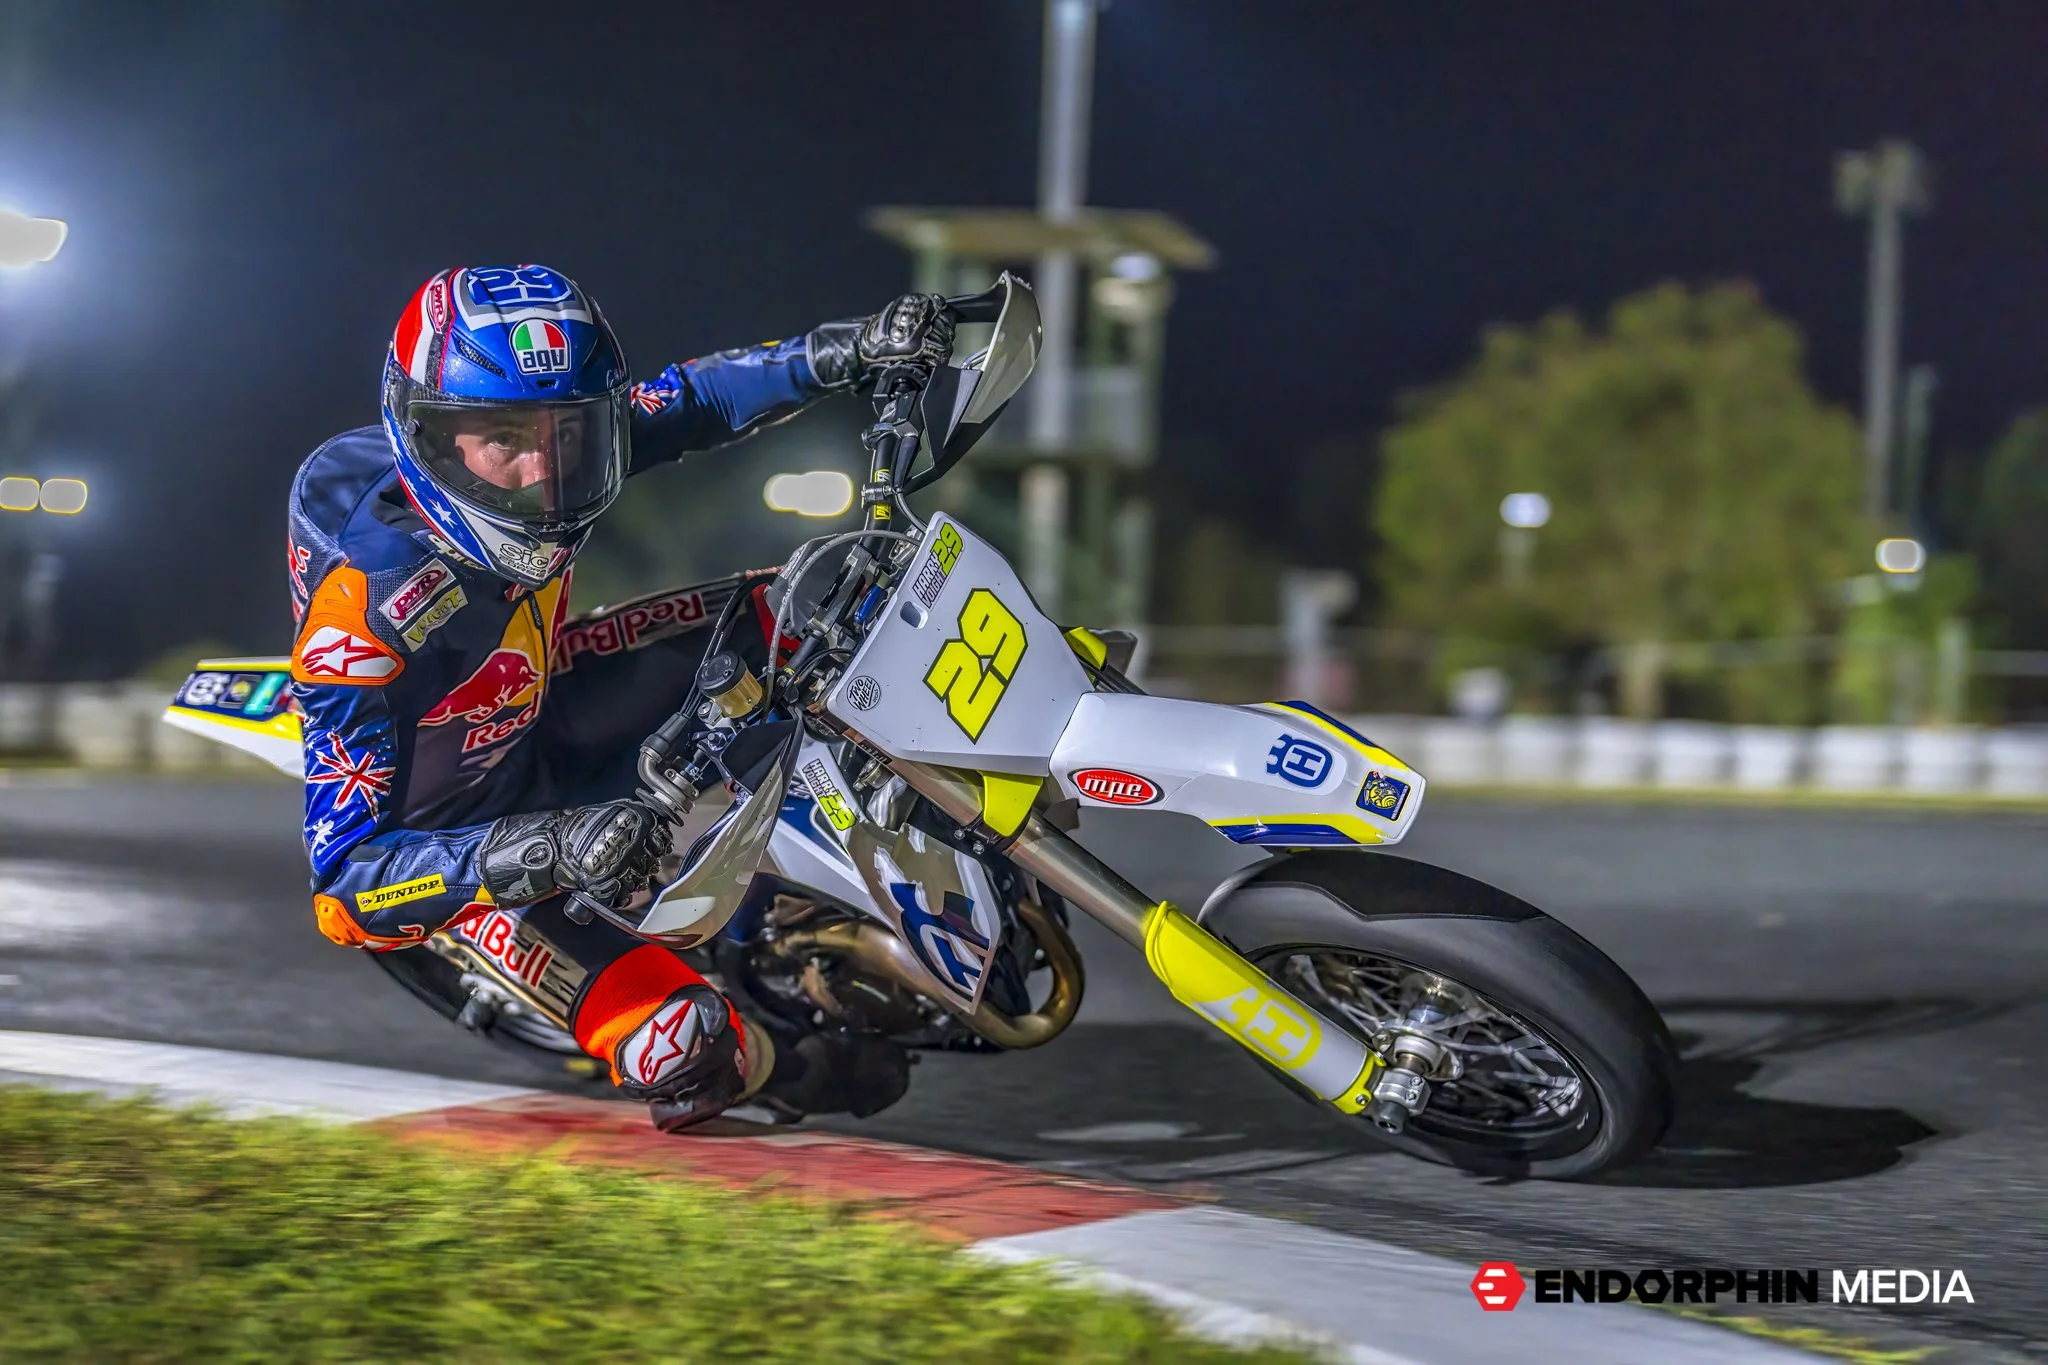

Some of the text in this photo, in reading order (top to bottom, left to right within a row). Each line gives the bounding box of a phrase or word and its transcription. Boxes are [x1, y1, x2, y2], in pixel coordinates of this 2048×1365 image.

[930, 522, 963, 577] 29
[912, 551, 942, 600] HARRY
[920, 565, 947, 609] VOIGHT
[624, 593, 706, 646] Red
[922, 588, 1028, 745] 29
[849, 678, 864, 702] TWO
[853, 677, 873, 711] WHEEL
[463, 690, 541, 752] Red
[810, 758, 838, 798] HARRY
[818, 789, 857, 831] 29
[375, 879, 441, 903] DUNLOP
[483, 913, 552, 988] Bull
